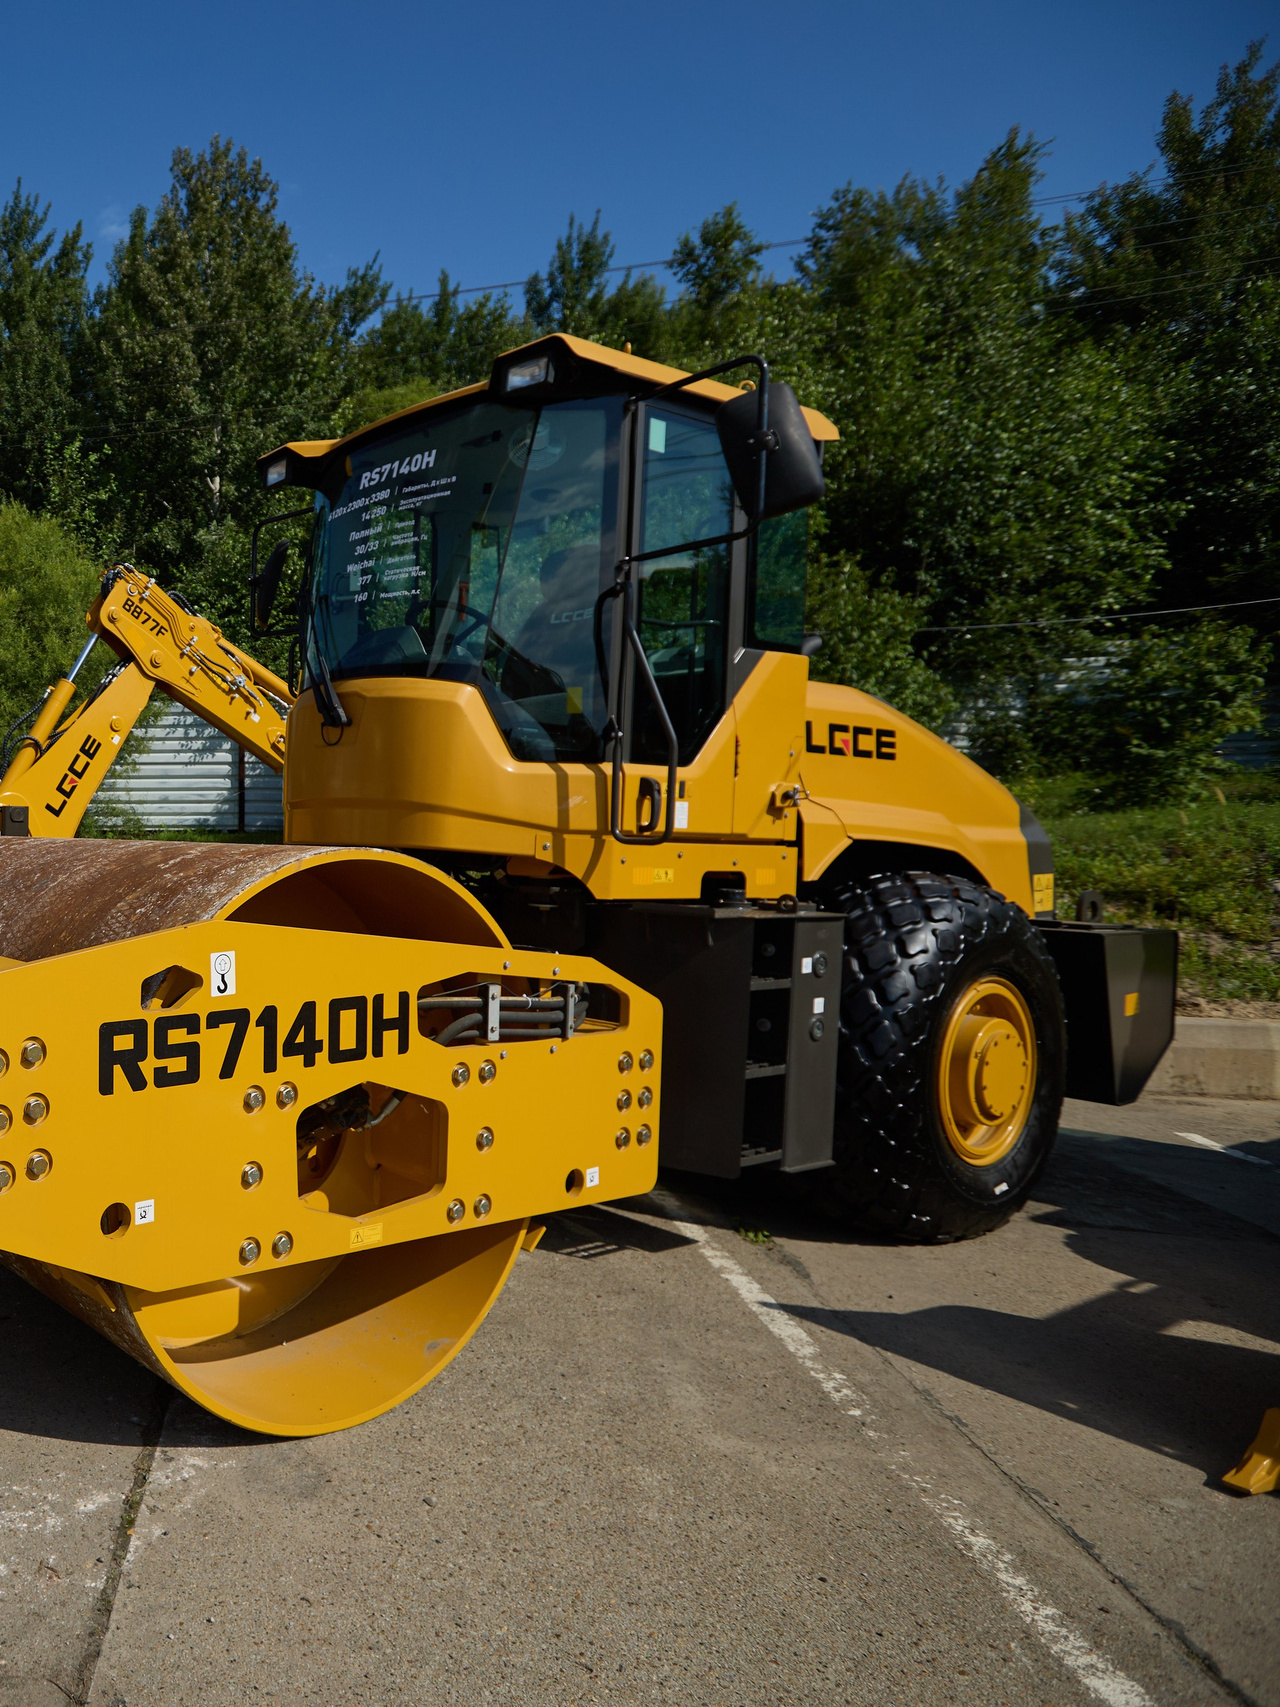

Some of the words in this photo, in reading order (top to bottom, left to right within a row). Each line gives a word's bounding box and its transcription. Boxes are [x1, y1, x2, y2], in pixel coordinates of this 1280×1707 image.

[359, 449, 437, 490] RS7140H
[349, 523, 383, 541] Полный
[354, 540, 380, 556] 30/33
[347, 557, 376, 573] Weichai
[357, 574, 372, 586] 377
[354, 592, 369, 603] 160
[805, 720, 897, 761] LGCE
[44, 733, 102, 818] LGCE
[98, 990, 410, 1096] RS7140H
